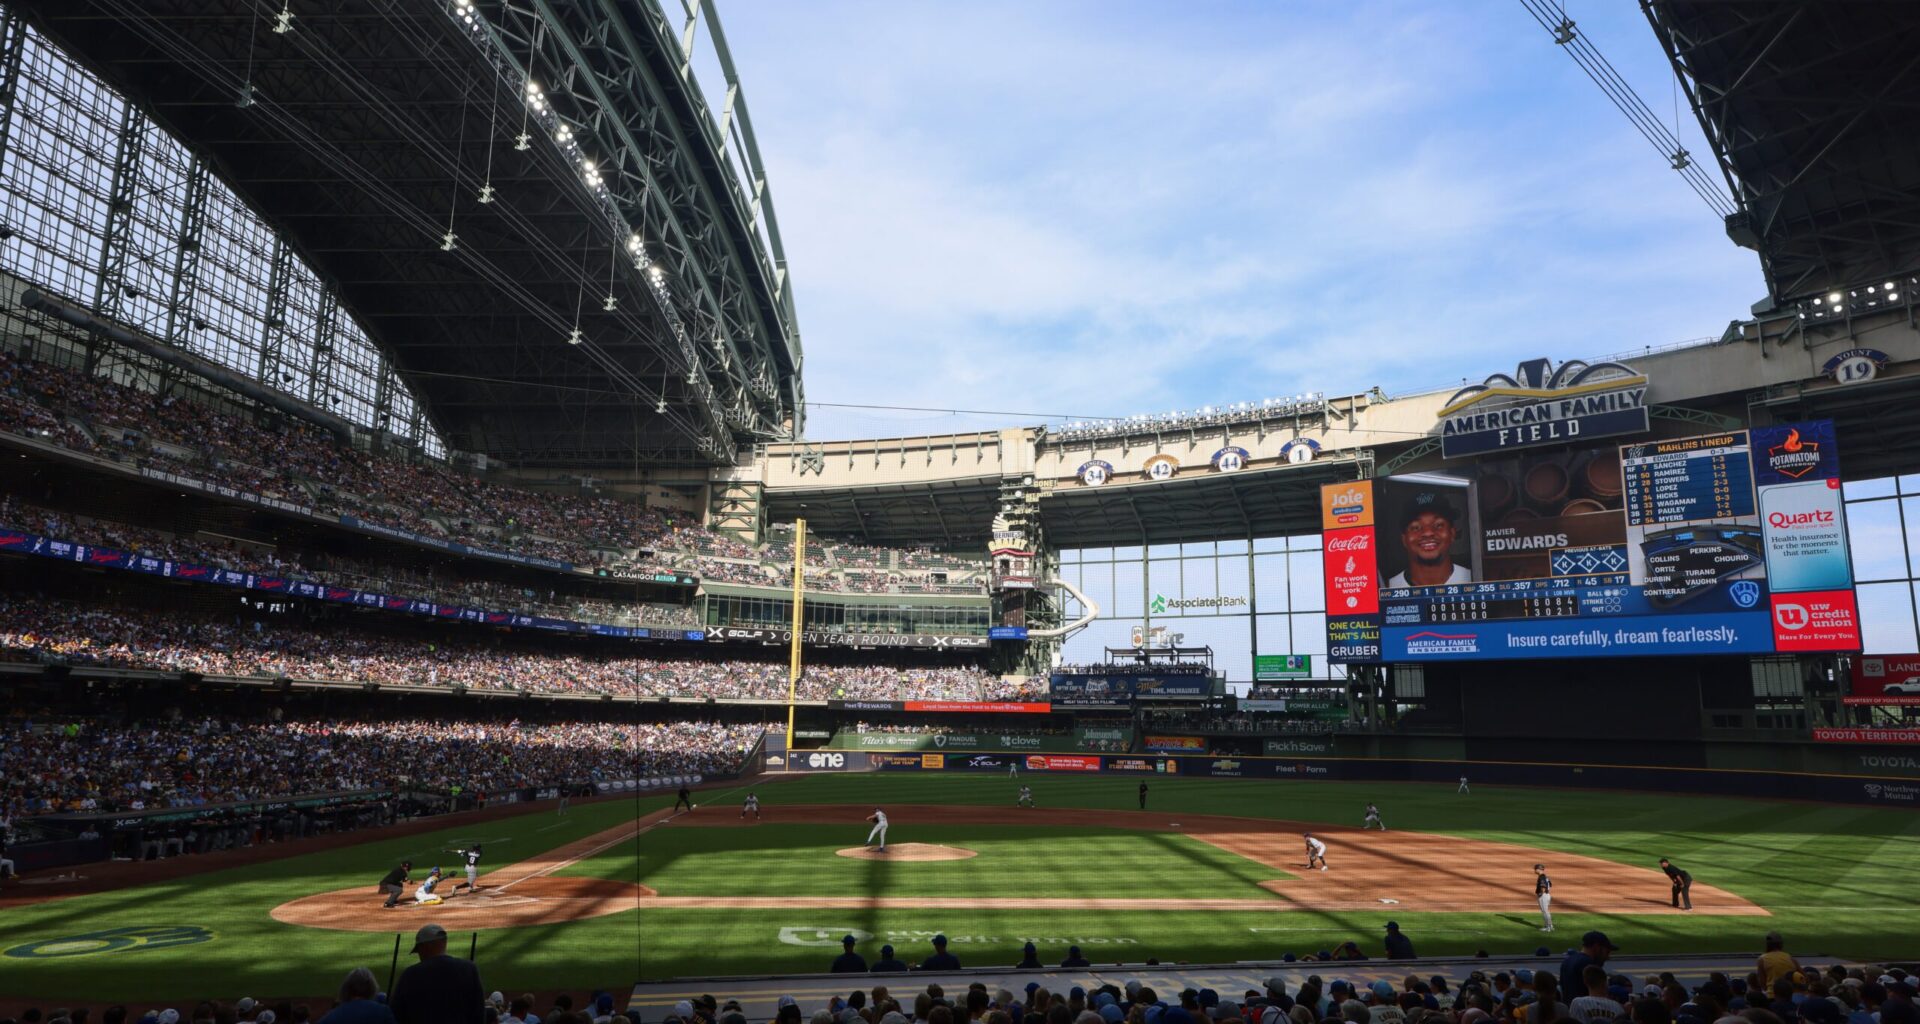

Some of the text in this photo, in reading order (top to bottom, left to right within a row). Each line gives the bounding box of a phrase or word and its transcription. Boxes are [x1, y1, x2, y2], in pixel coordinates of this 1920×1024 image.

[1836, 349, 1873, 361] YOUNT
[1842, 362, 1872, 380] 19
[1443, 387, 1647, 436] AMERICAN FAMILY
[1499, 419, 1580, 446] FIELD
[1700, 437, 1734, 448] LINEUP
[1653, 453, 1689, 462] EDWARDS
[1769, 452, 1820, 466] POTAWATOMI
[1222, 457, 1239, 470] 44
[1153, 463, 1170, 477] 42
[1088, 470, 1103, 482] 34
[1655, 475, 1690, 485] STOWERS
[1331, 488, 1364, 506] Joie
[1656, 492, 1679, 500] HICKS
[1658, 506, 1686, 515] PAULEY
[1658, 515, 1684, 523] MYERS
[1768, 510, 1834, 529] Quartz
[1486, 528, 1516, 537] XAVIER
[1487, 533, 1569, 551] EDWARDS
[1771, 532, 1839, 543] Health insurance
[1786, 541, 1799, 549] the
[1800, 540, 1839, 548] moments
[1689, 546, 1722, 555] PERKINS
[1783, 548, 1830, 557] that matter.
[1586, 559, 1592, 567] K
[1611, 557, 1617, 565] K
[1650, 555, 1680, 564] COLLINS
[1562, 561, 1568, 569] K
[613, 571, 655, 582] CASAMIGOS
[1685, 568, 1716, 577] TURANG
[1349, 574, 1368, 582] work
[1685, 578, 1717, 586] VAUGHN
[1343, 580, 1367, 589] thirsty
[1392, 589, 1410, 598] .290
[1447, 586, 1459, 595] 26
[1477, 584, 1496, 593] .355
[1512, 582, 1531, 591] .357
[1552, 579, 1570, 588] .712
[1585, 577, 1597, 586] 45
[1614, 576, 1625, 584] 17
[1643, 588, 1686, 597] CONTRERAS
[1167, 595, 1247, 609] Associated Bank
[1582, 598, 1604, 606] STRIKE
[1810, 603, 1830, 611] uw
[1811, 609, 1850, 619] credit
[1329, 621, 1378, 630] ONE CALL...
[1812, 618, 1853, 628] union
[707, 626, 988, 647] X GOLF YEAR ROUND X GOLF
[1329, 631, 1379, 641] THAT'S ALL!
[1507, 626, 1739, 648] Insure carefully, dream fearlessly.
[1814, 632, 1836, 641] Every
[1408, 639, 1476, 648] AMERICAN FAMILY
[1331, 645, 1379, 657] GRUBER
[1888, 663, 1920, 672] LAND
[1011, 735, 1041, 745] clover
[1815, 730, 1920, 741] TOYOTA TERRITORY
[862, 736, 886, 745] Tito's
[1268, 741, 1289, 751] Pick
[1299, 742, 1326, 751] Save
[808, 752, 844, 768] one
[1275, 765, 1297, 773] Fleet
[1884, 792, 1915, 801] Mutual
[1017, 936, 1139, 945] union
